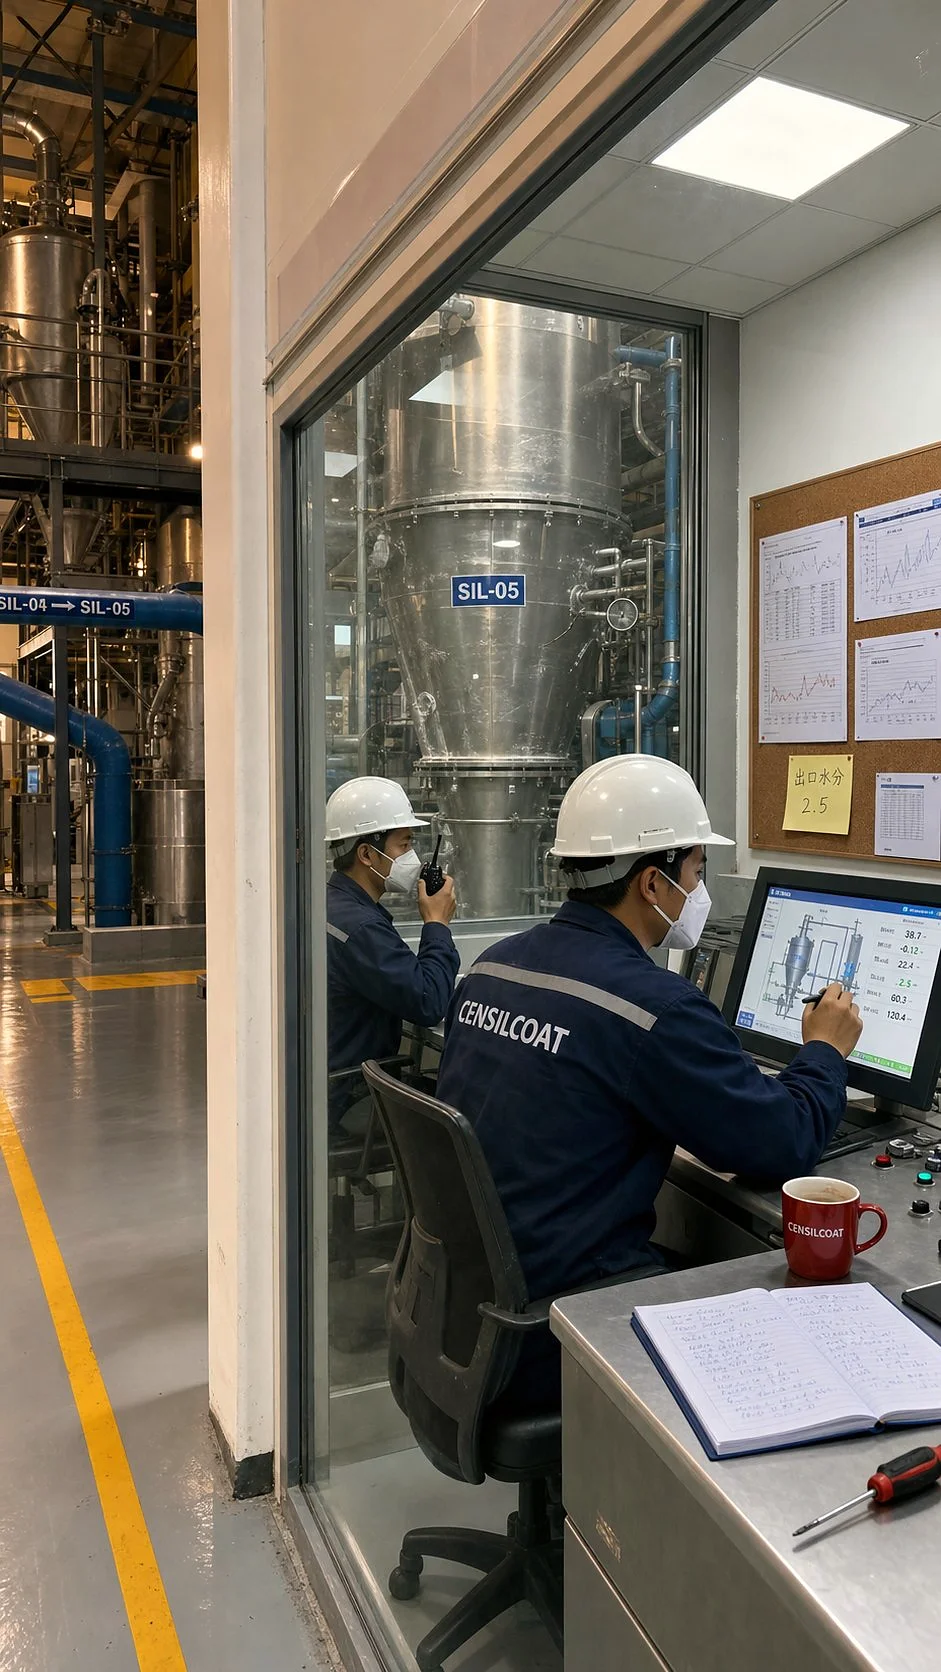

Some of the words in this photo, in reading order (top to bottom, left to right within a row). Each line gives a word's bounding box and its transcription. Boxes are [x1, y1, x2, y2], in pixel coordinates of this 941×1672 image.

[457, 581, 520, 600] SIL-05
[0, 597, 48, 612] SIL-04
[80, 600, 131, 616] SIL-05
[794, 767, 845, 786] 出口水分
[801, 796, 829, 814] 2.5
[904, 930, 922, 940] 38.7
[897, 960, 914, 970] 22.4
[890, 993, 907, 1004] 60.3
[886, 1010, 906, 1021] 120.4
[458, 1000, 571, 1055] CENSILCOAT
[787, 1221, 845, 1238] CENSILCOAT
